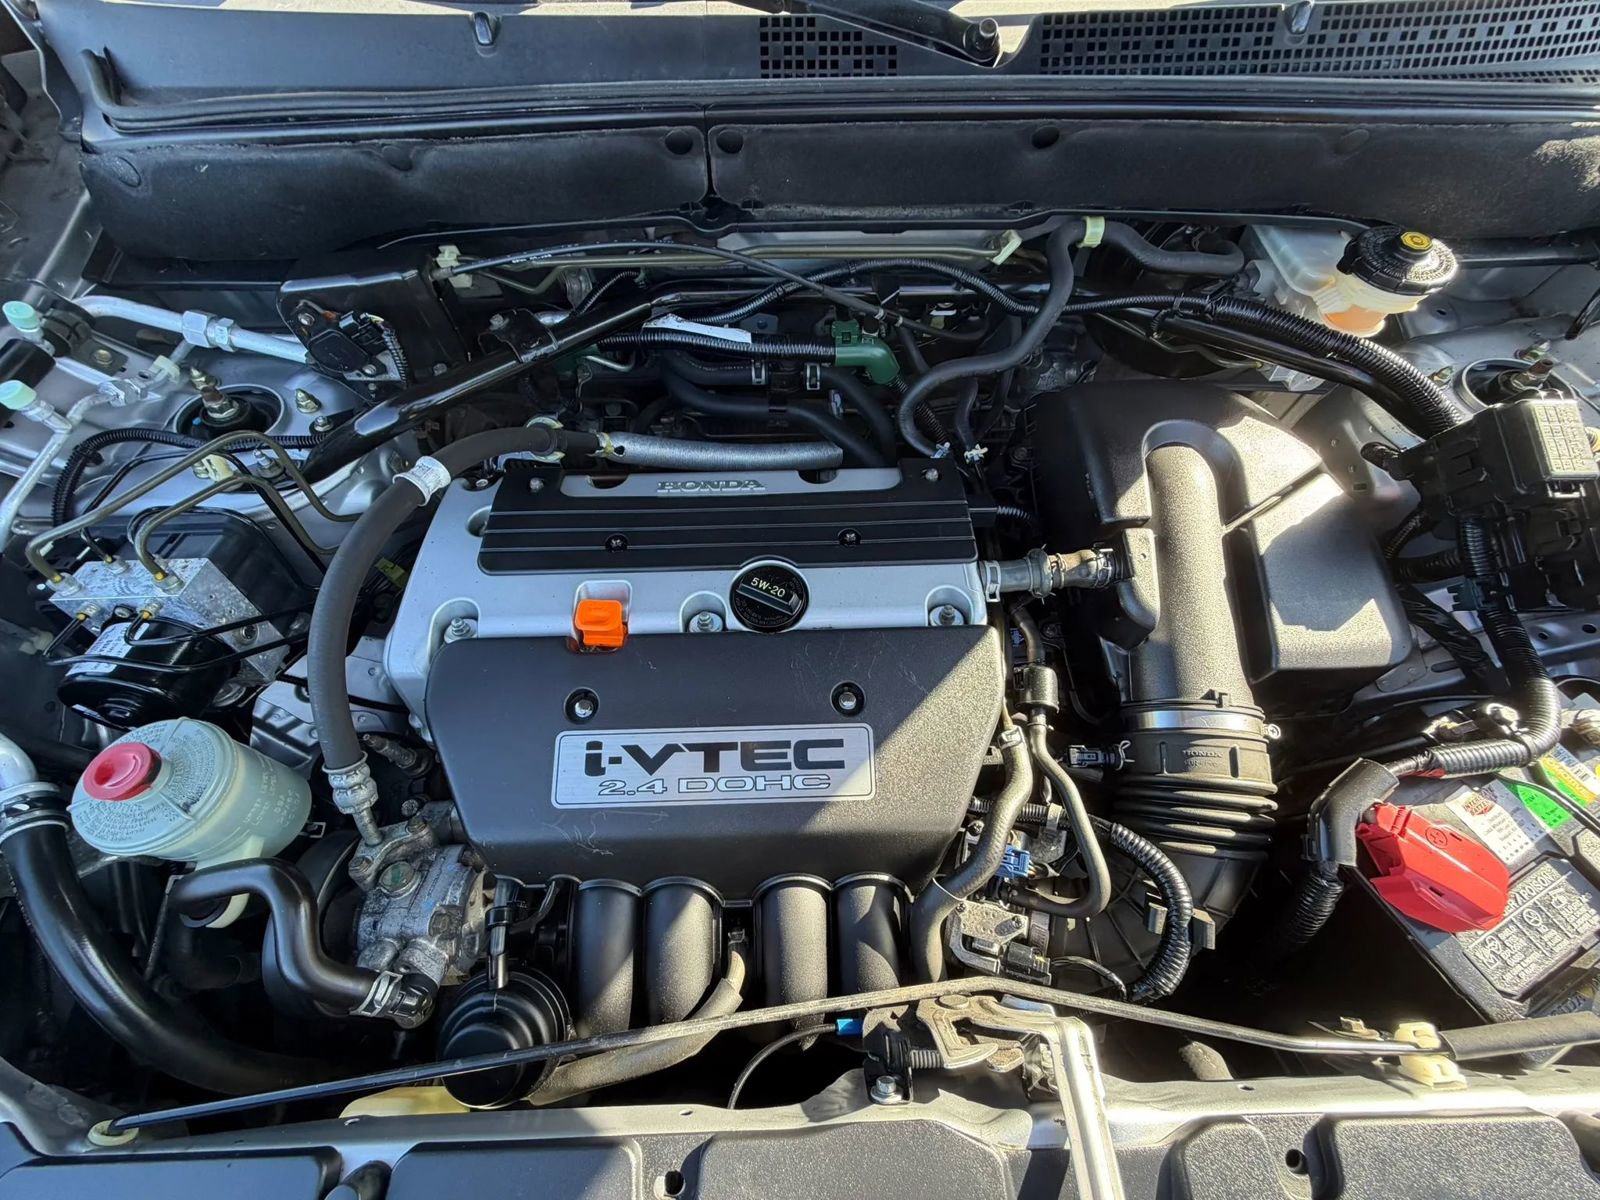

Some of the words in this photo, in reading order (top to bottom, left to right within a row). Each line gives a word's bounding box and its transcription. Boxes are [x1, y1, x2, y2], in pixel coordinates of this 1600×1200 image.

[657, 479, 766, 493] HONDA
[750, 577, 786, 598] 5W-20
[584, 738, 845, 777] i-VTEC
[598, 777, 668, 797] 2.4
[678, 774, 830, 794] DOHC
